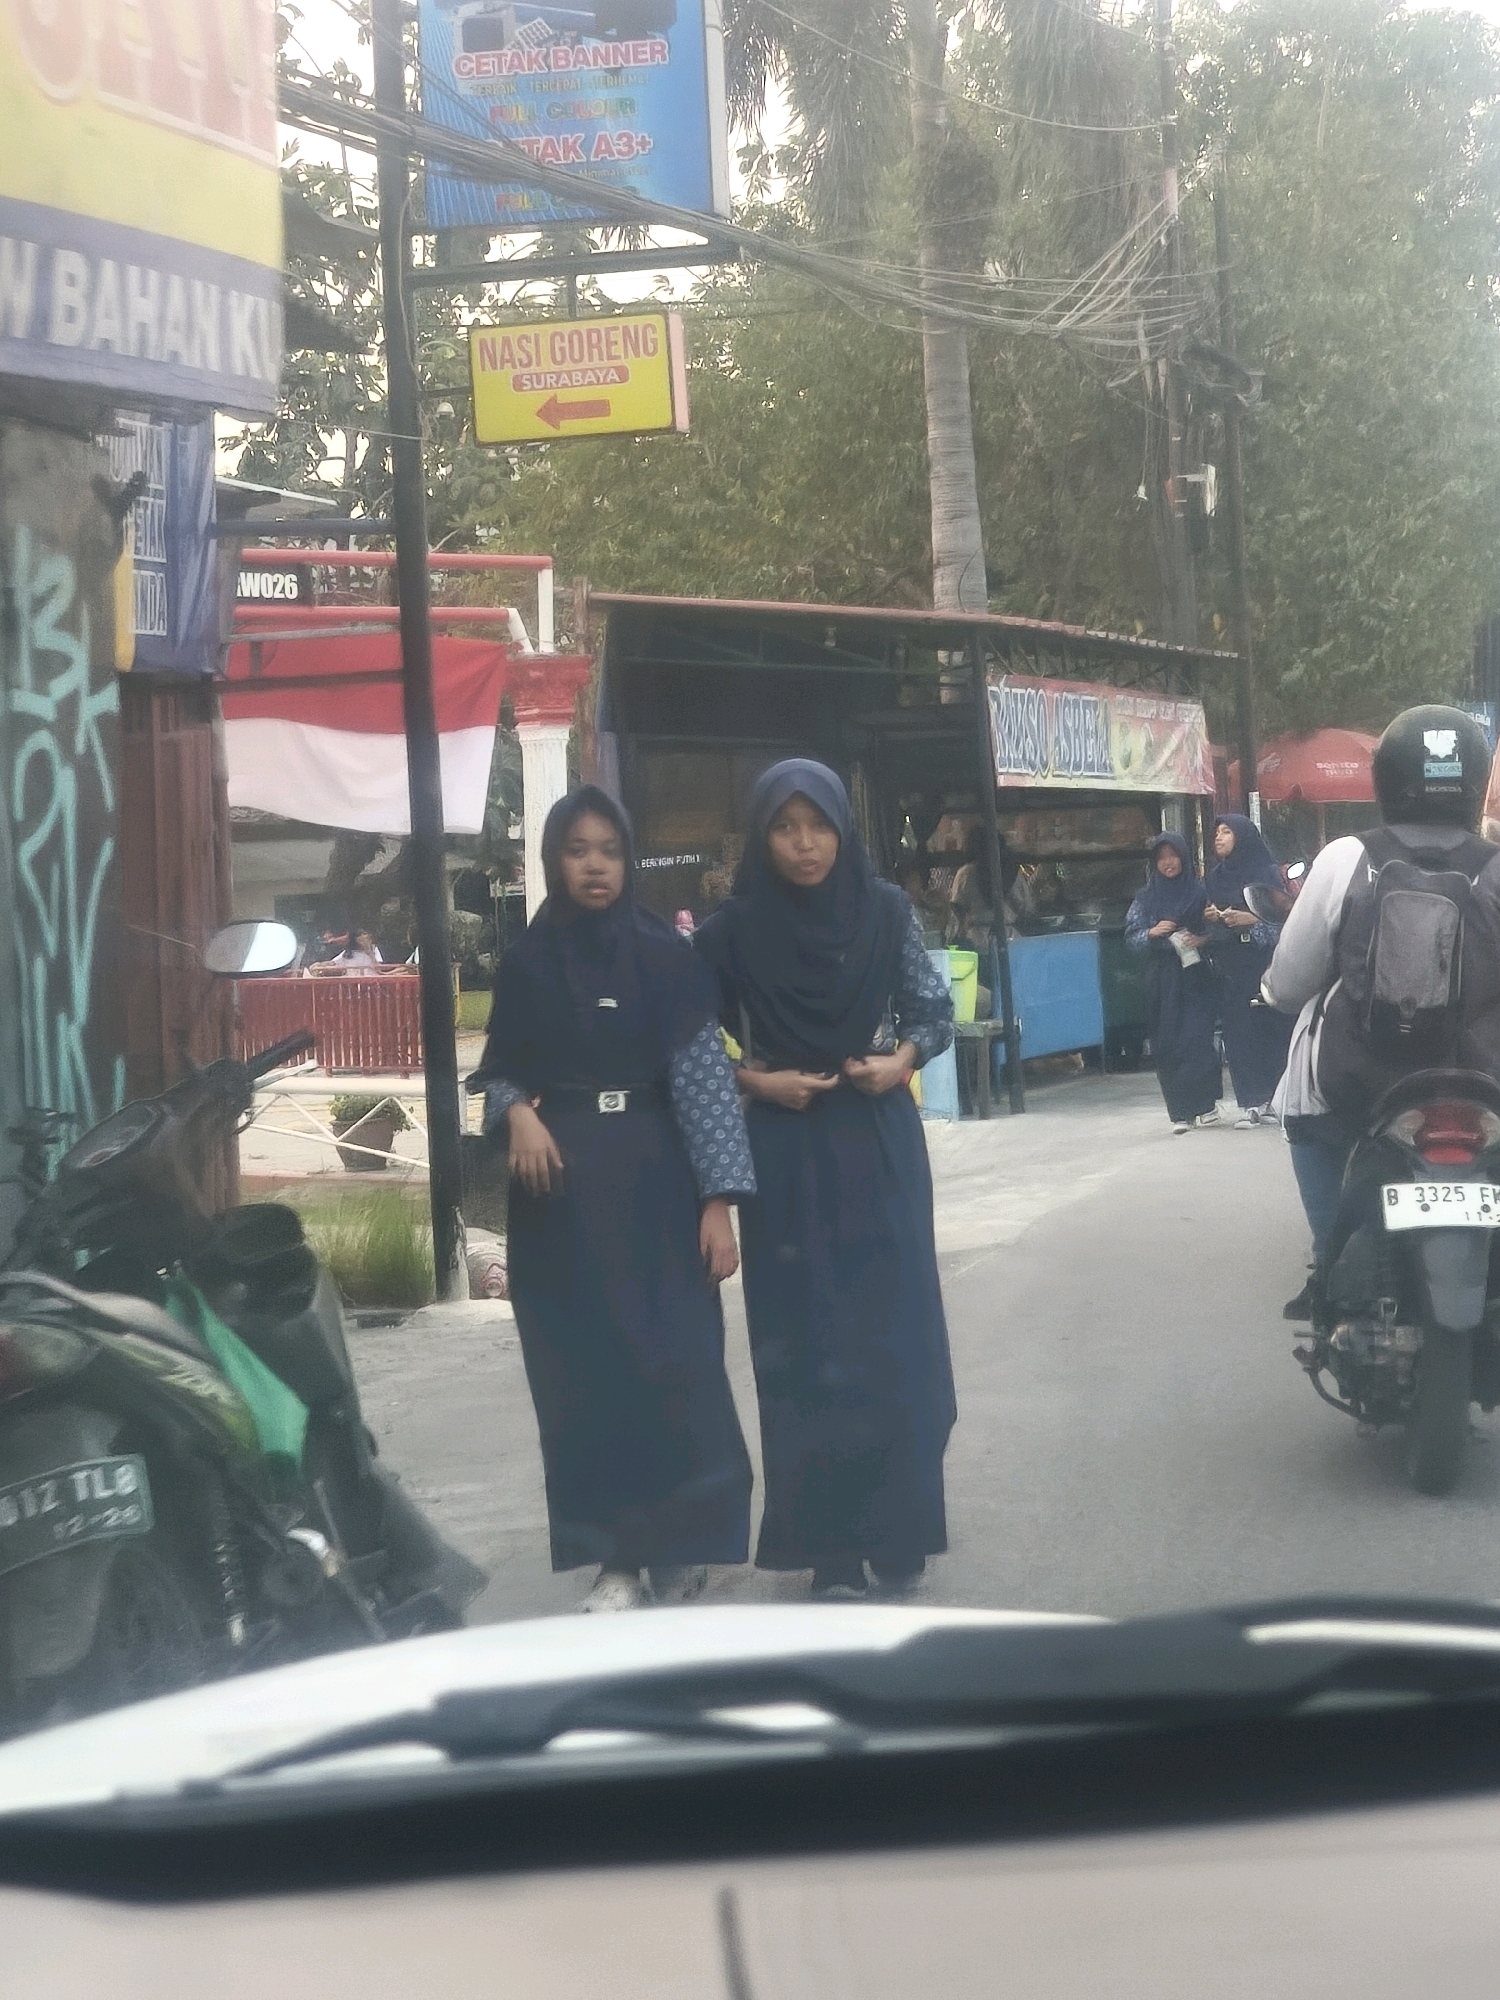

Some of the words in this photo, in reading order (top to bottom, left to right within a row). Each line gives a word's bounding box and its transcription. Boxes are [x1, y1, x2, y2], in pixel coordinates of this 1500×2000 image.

[453, 48, 549, 79] CETAK
[550, 40, 669, 72] BANNER
[489, 101, 537, 122] FULL
[591, 130, 654, 161] A3+
[48, 247, 221, 374] BAHAN
[478, 332, 541, 372] NASI
[551, 323, 659, 366] GORENG
[521, 367, 621, 390] SURABAYA
[1386, 1188, 1398, 1206] B
[1414, 1186, 1465, 1202] 3325
